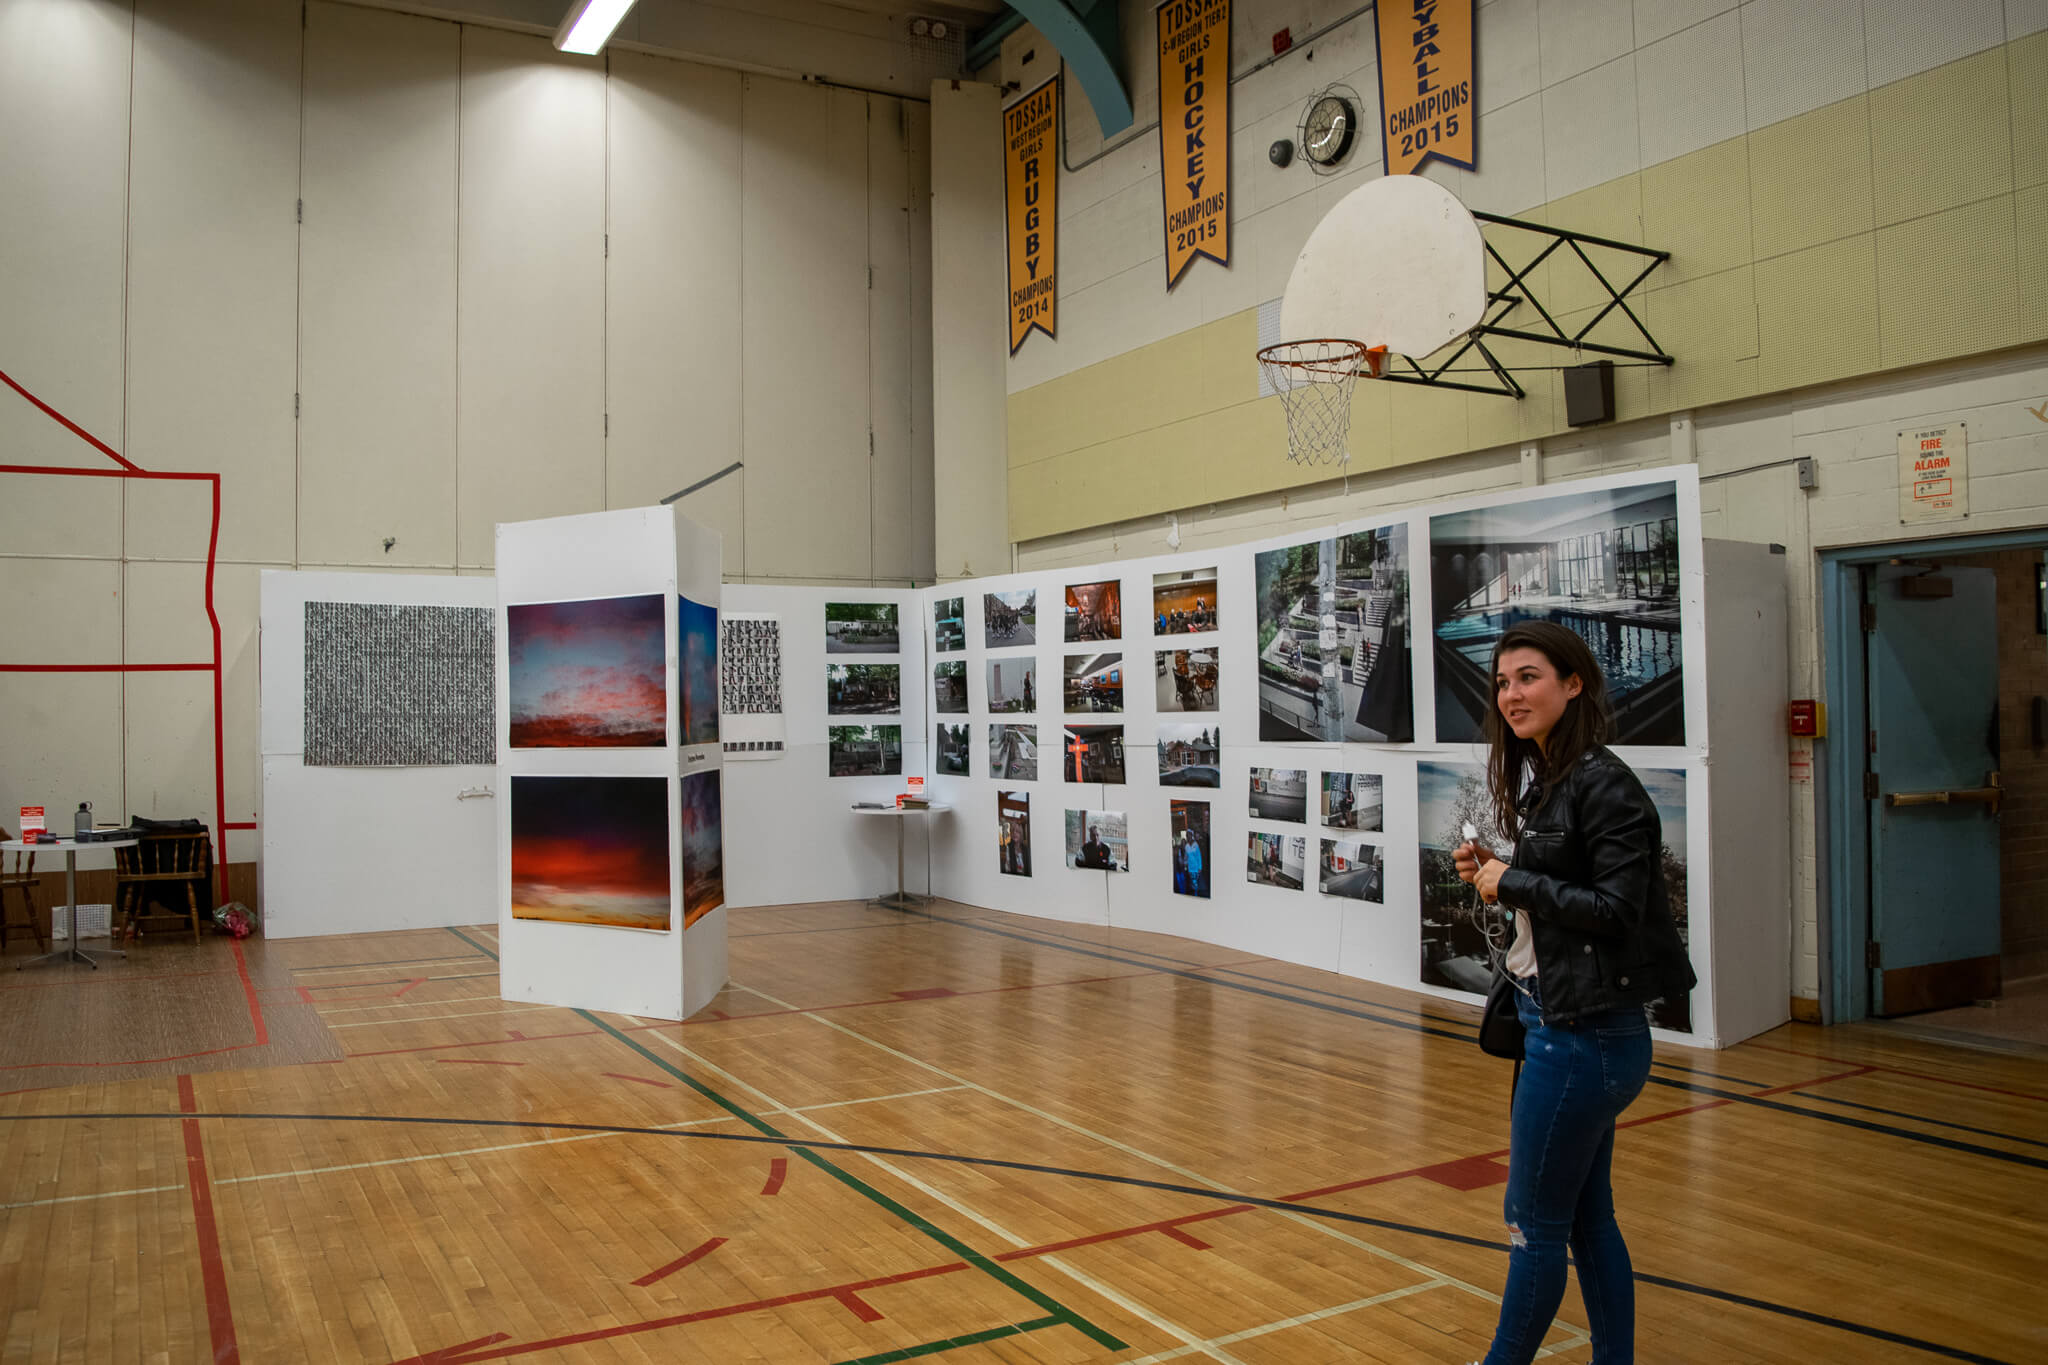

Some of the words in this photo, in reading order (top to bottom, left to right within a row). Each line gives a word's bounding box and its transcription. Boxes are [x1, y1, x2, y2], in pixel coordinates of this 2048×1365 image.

[1178, 20, 1202, 47] REGION
[1205, 9, 1220, 30] TIER
[1179, 34, 1210, 64] GIRLS
[1009, 89, 1051, 137] TDSSAA
[1389, 80, 1468, 136] CHAMPIONS
[1011, 130, 1028, 152] WEST
[1029, 115, 1052, 140] REGION
[1184, 56, 1206, 201] HOCKEY
[1401, 113, 1459, 158] 2015
[1019, 138, 1043, 162] GIRLS
[1025, 158, 1040, 281] RUGBY
[1169, 192, 1224, 233] CHAMPIONS
[1177, 219, 1217, 252] 2015
[1013, 275, 1053, 308] CHAMPIONS
[1018, 297, 1048, 323] 2014
[1920, 438, 1942, 450] FIRE
[1914, 456, 1950, 472] ALARM
